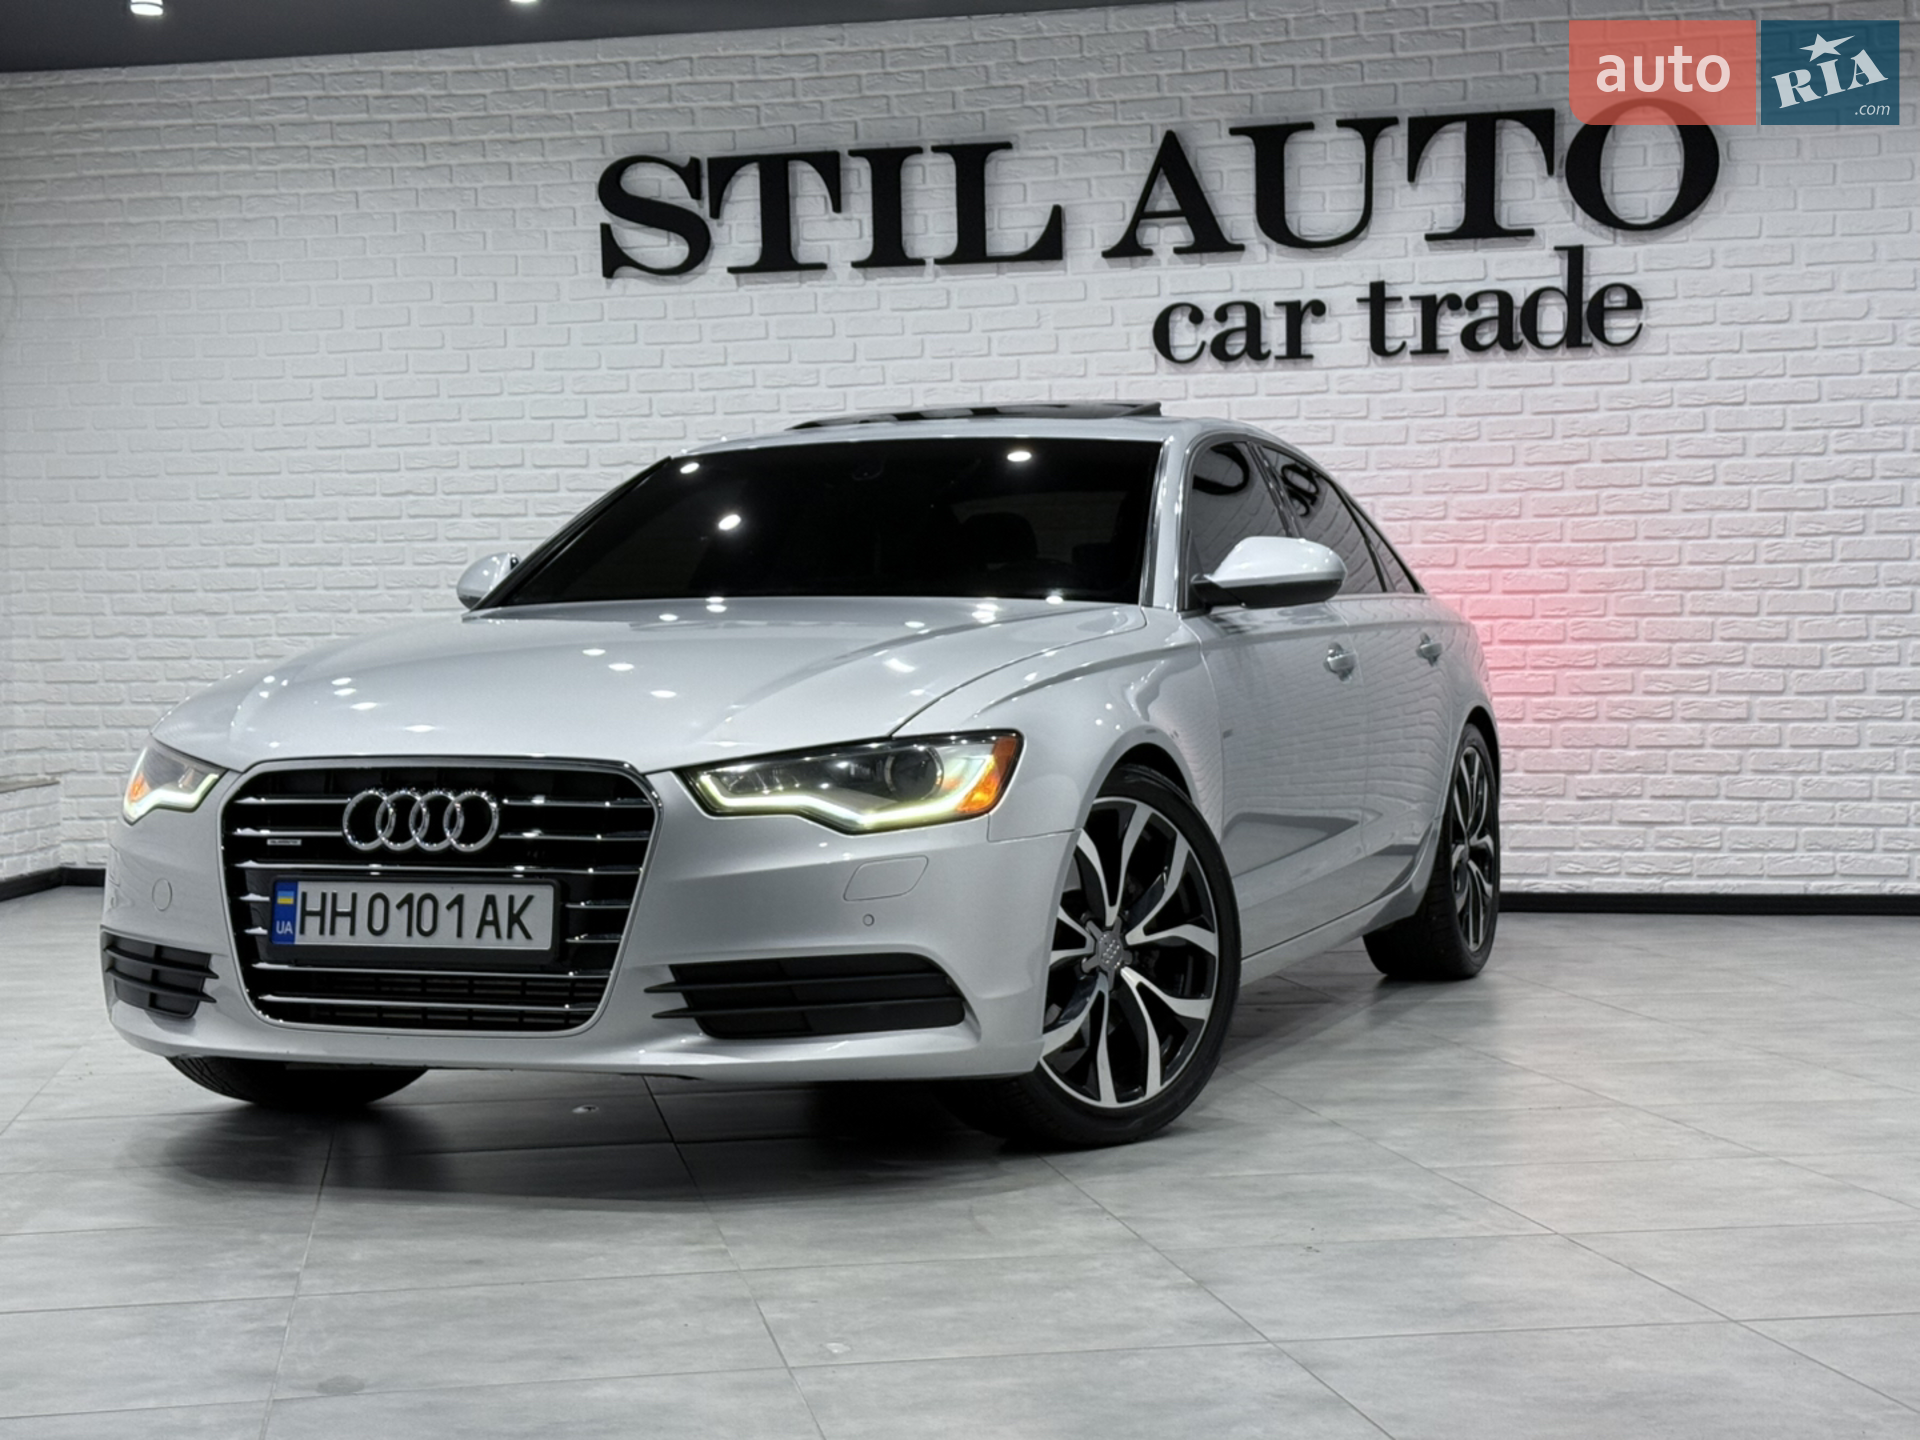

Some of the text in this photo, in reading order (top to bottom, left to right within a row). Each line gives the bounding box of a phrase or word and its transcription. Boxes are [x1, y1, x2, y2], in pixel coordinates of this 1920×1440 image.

[597, 98, 1720, 280] STIL AUTO
[1153, 245, 1643, 364] car trade
[275, 920, 293, 935] UA
